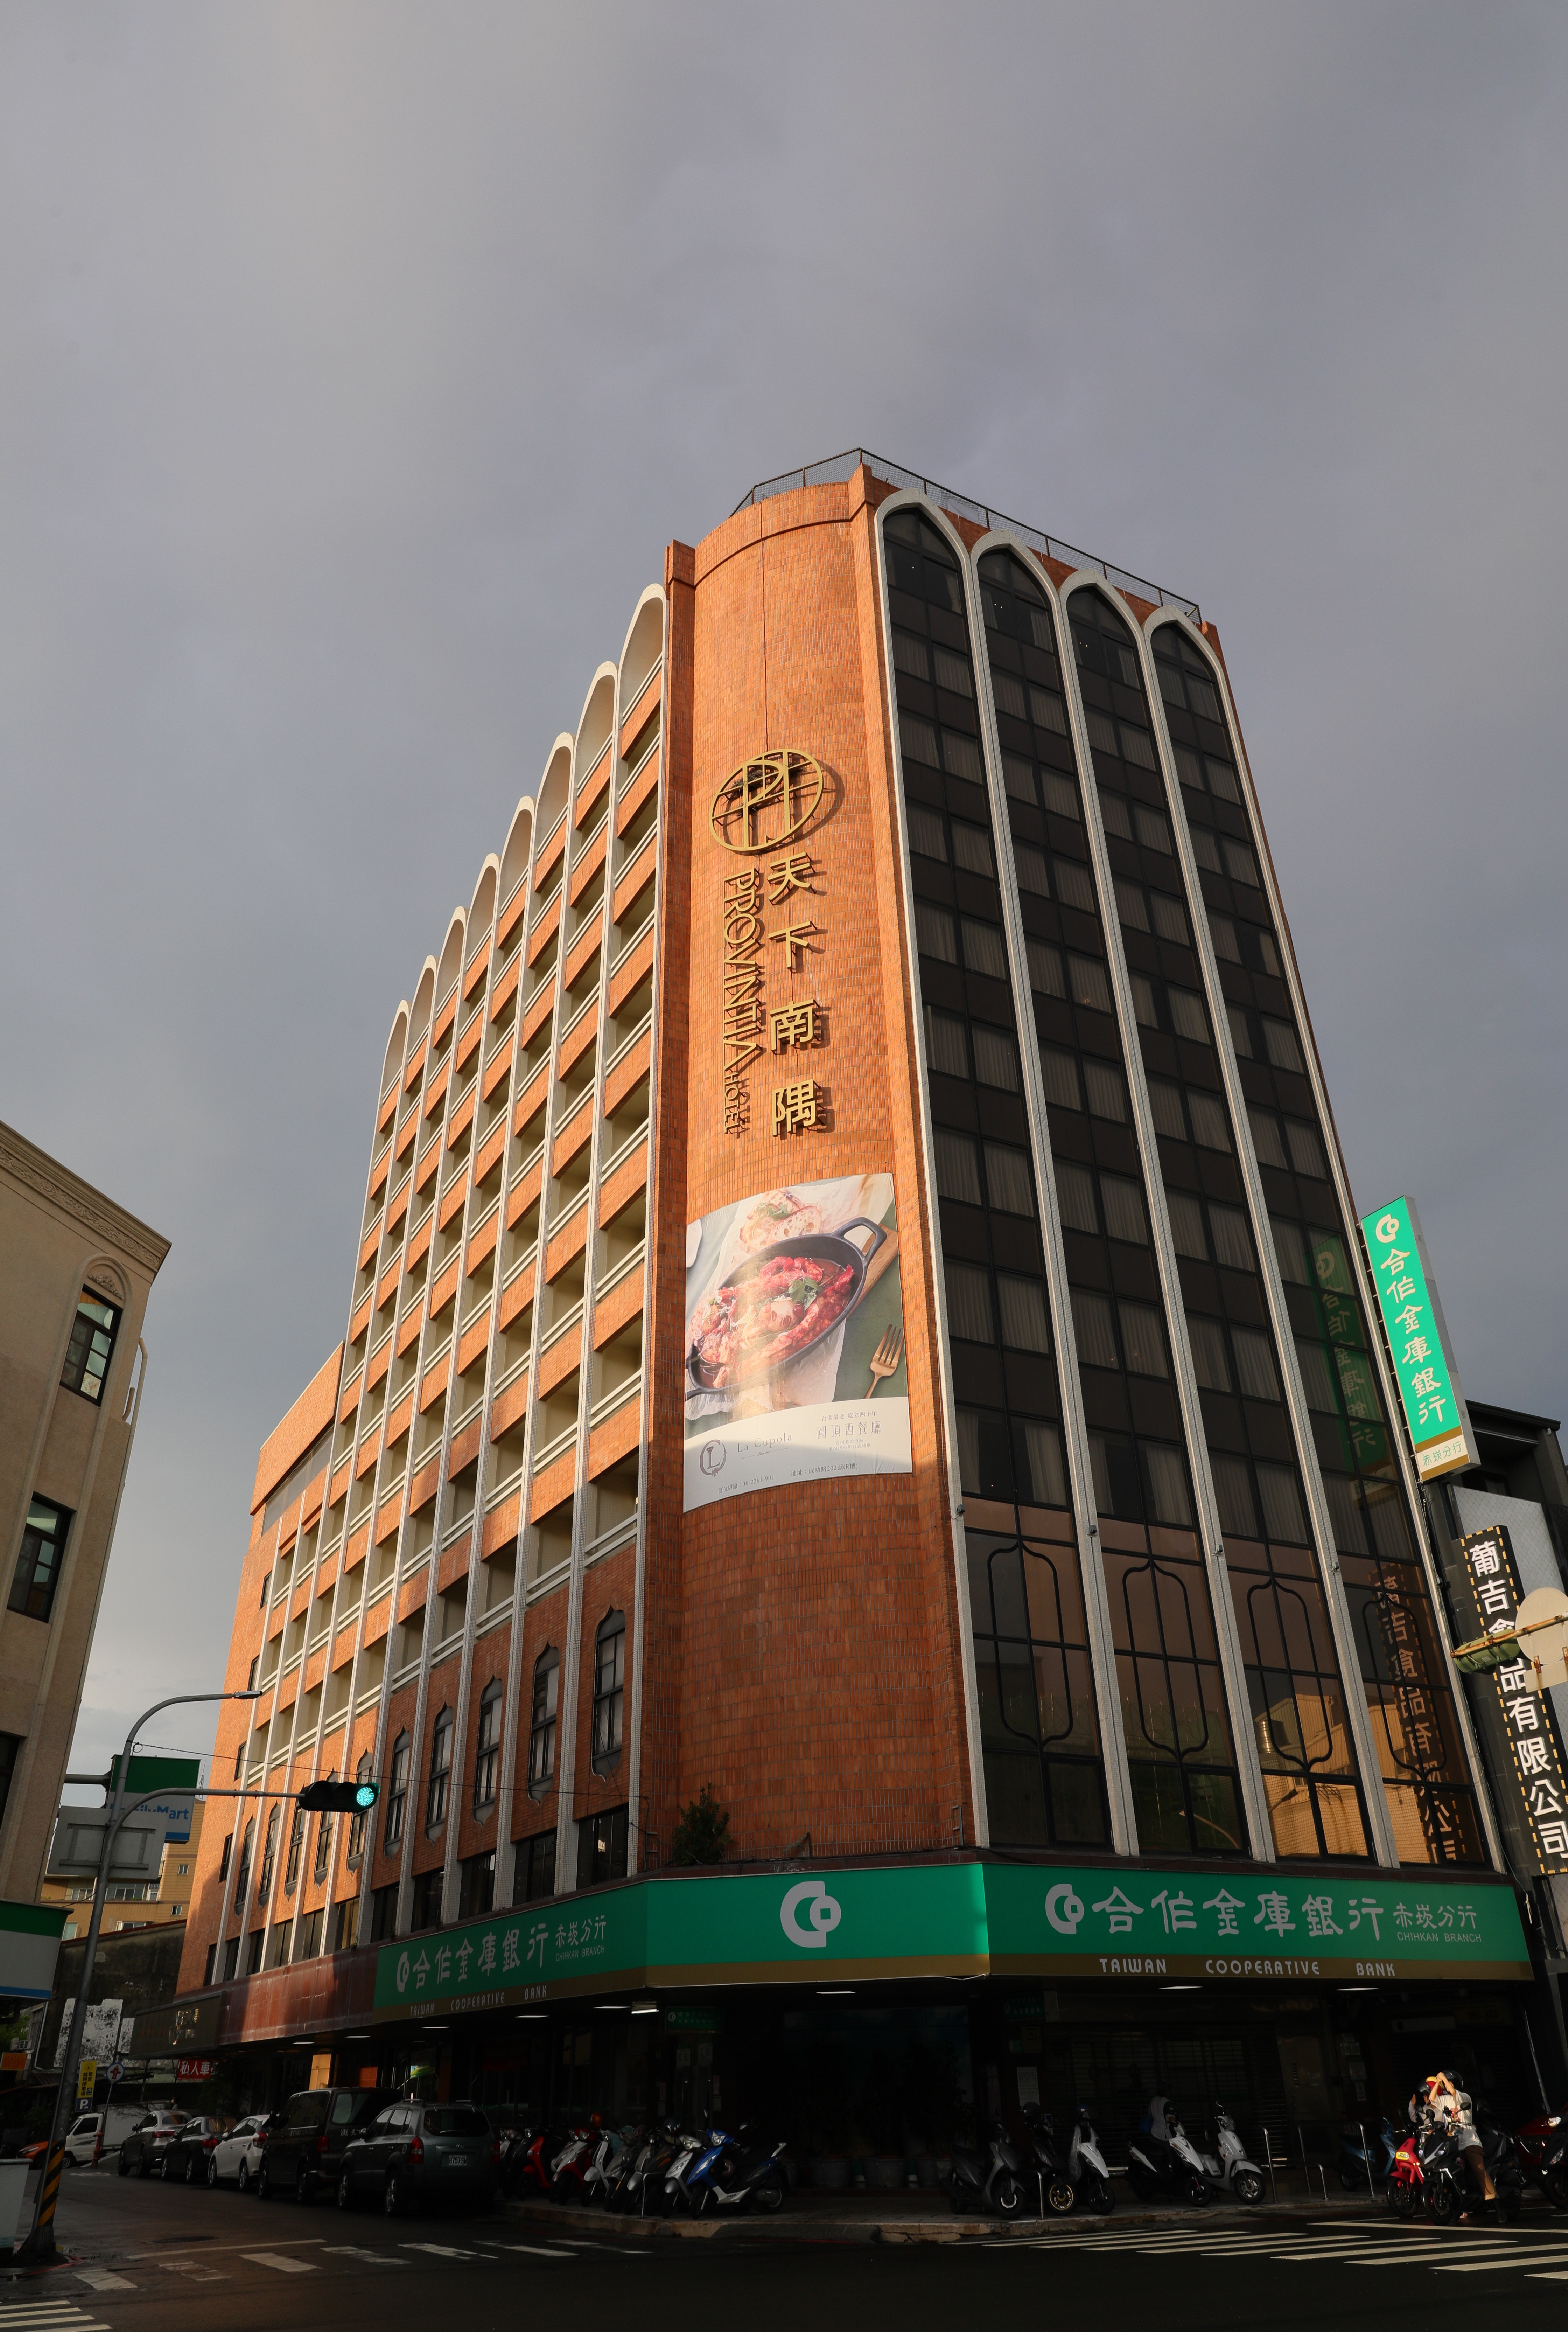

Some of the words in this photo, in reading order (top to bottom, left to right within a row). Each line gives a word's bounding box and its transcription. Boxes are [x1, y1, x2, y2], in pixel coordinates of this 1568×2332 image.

[723, 868, 757, 1071] PROVINTIA
[767, 851, 817, 1137] 天下南隅
[724, 1072, 740, 1133] HOTEL
[1380, 1248, 1446, 1425] 合作金庫銀行
[817, 1420, 882, 1439] 圓頂西餐廳
[821, 1413, 845, 1421] 台南最老
[737, 1443, 748, 1453] La
[754, 1432, 792, 1448] Cupola
[1422, 1441, 1462, 1467] 赤崁分行
[1092, 1886, 1384, 1941] 合作金庫銀行
[1393, 1902, 1477, 1929] 赤崁分行
[555, 1915, 607, 1948] 赤崁分行
[1397, 1931, 1438, 1942] CHIHKAN
[1444, 1933, 1482, 1942] BRANCH
[413, 1923, 549, 1989] 合作金庫銀行
[555, 1950, 579, 1962] CHIHKAN
[582, 1944, 605, 1956] BRANCH
[1100, 1958, 1166, 1974] TAIWAN
[1206, 1959, 1320, 1975] COOPERATIVE
[1356, 1962, 1395, 1977] BANK
[410, 2003, 435, 2016] TAIWAN
[451, 1991, 505, 2011] COOPERATIVE
[524, 1985, 547, 2000] BANK
[80, 2098, 89, 2109] P
